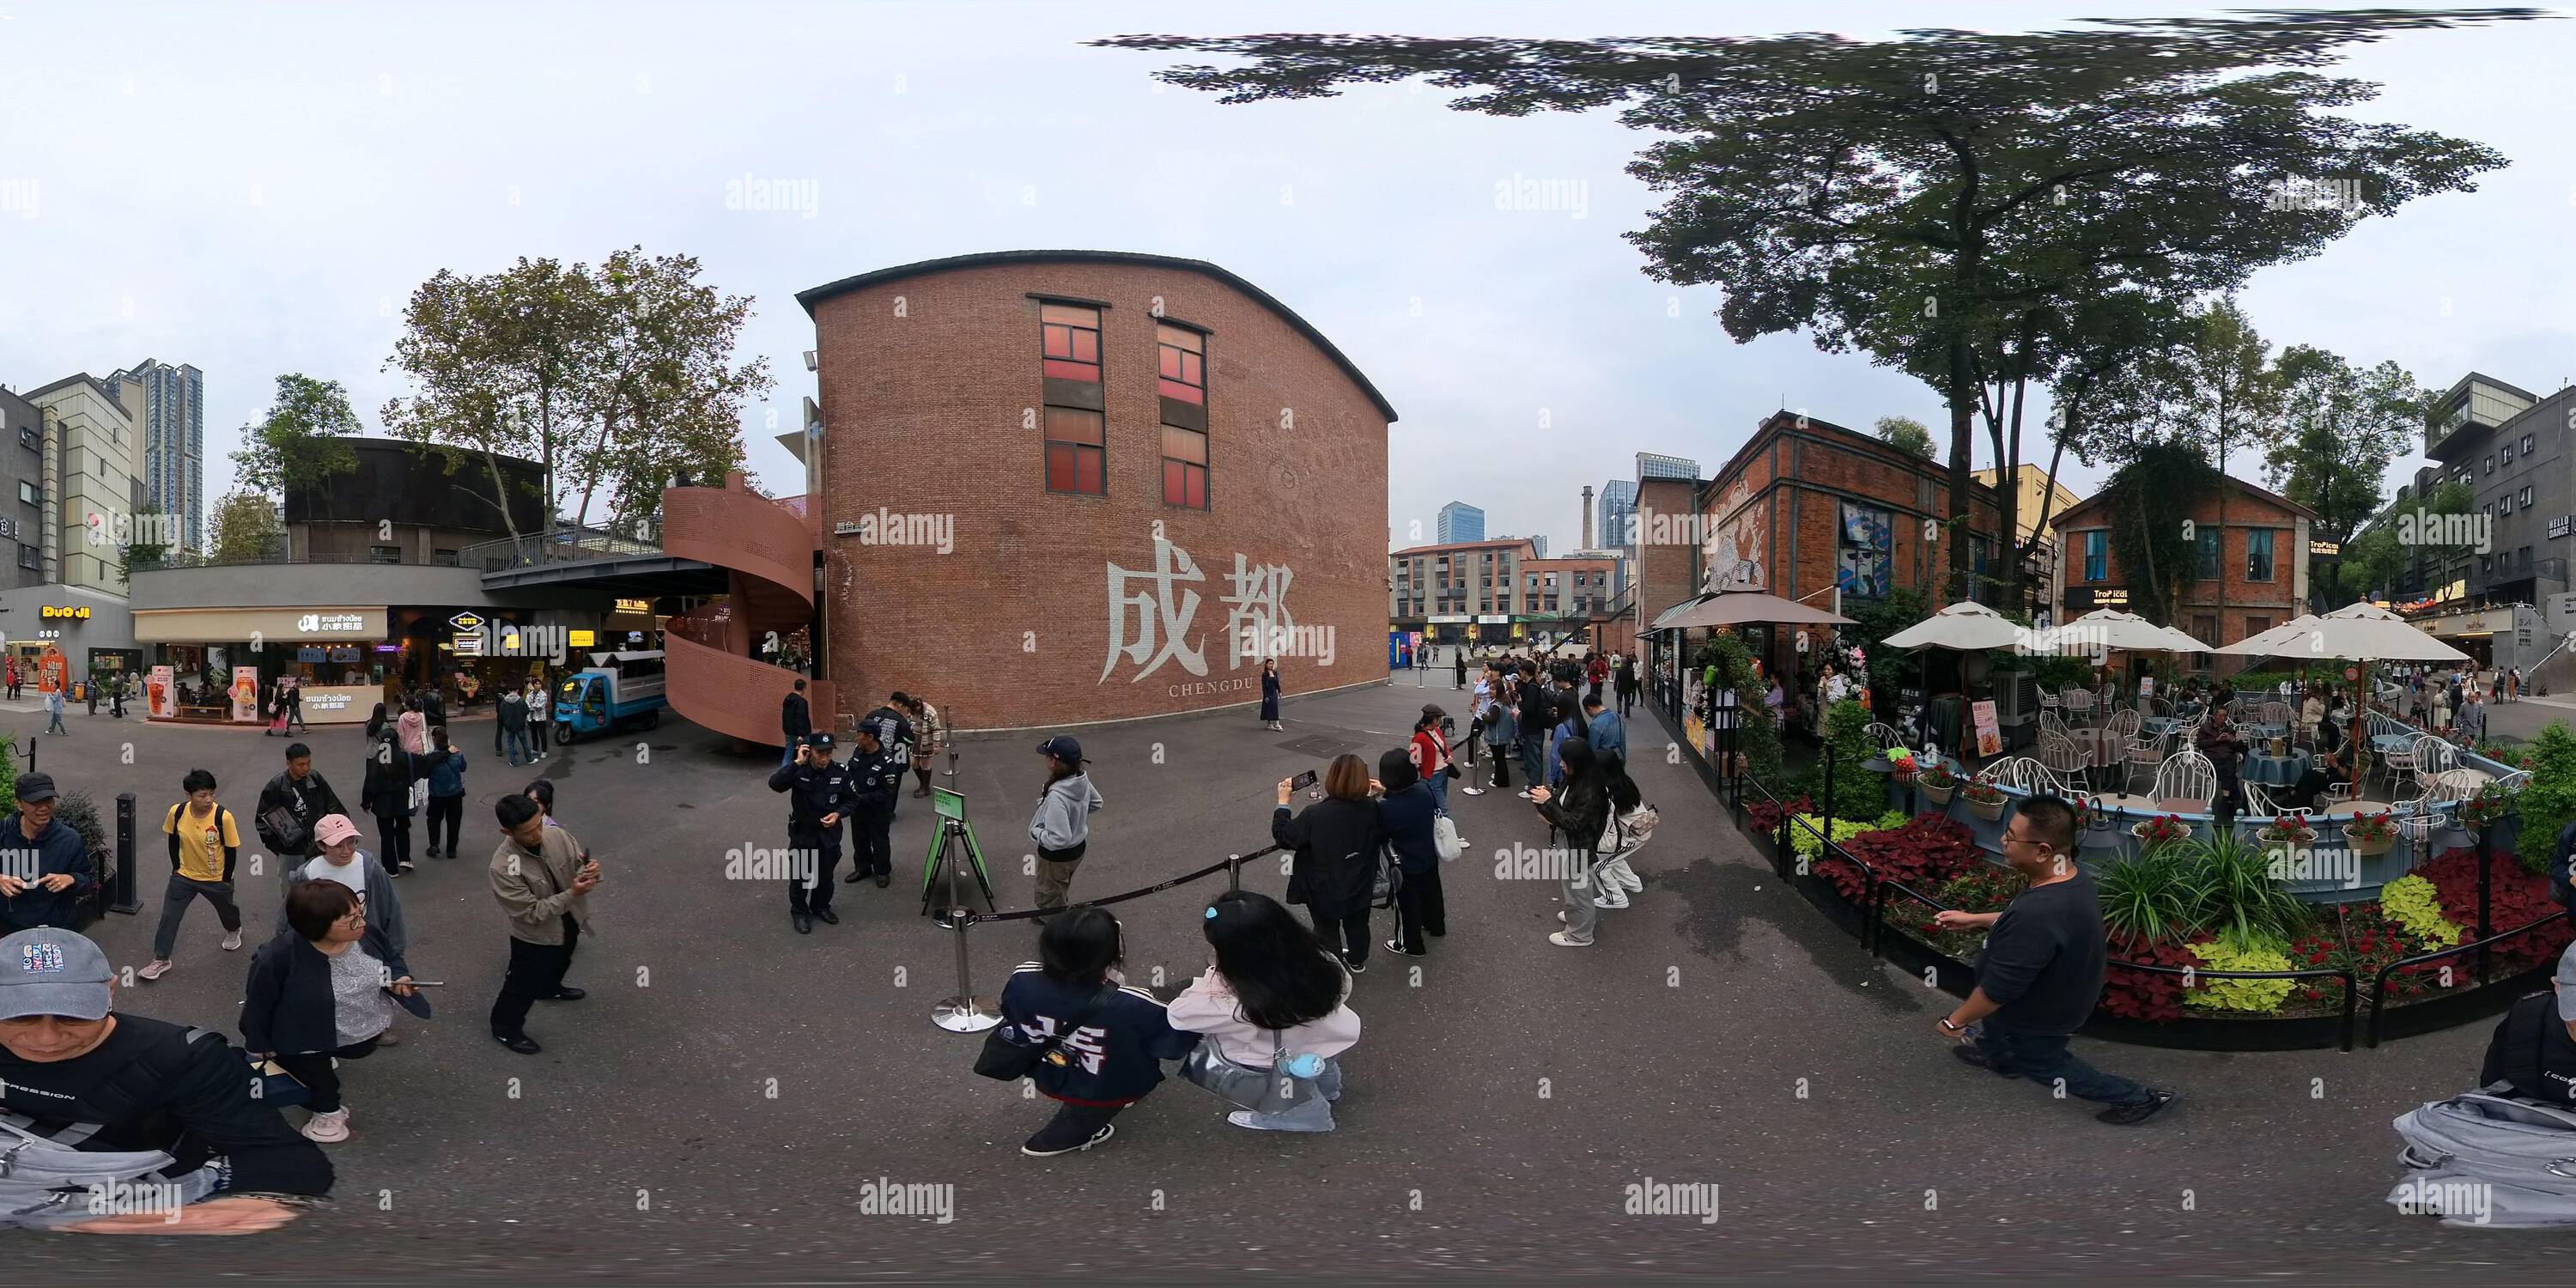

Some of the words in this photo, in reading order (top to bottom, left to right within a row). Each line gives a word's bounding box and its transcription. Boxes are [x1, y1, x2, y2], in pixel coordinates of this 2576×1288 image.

[2549, 515, 2569, 529] HELLO
[2549, 525, 2569, 539] DANCE
[1097, 537, 1294, 686] 成都
[1169, 677, 1253, 697] CHENGDU
